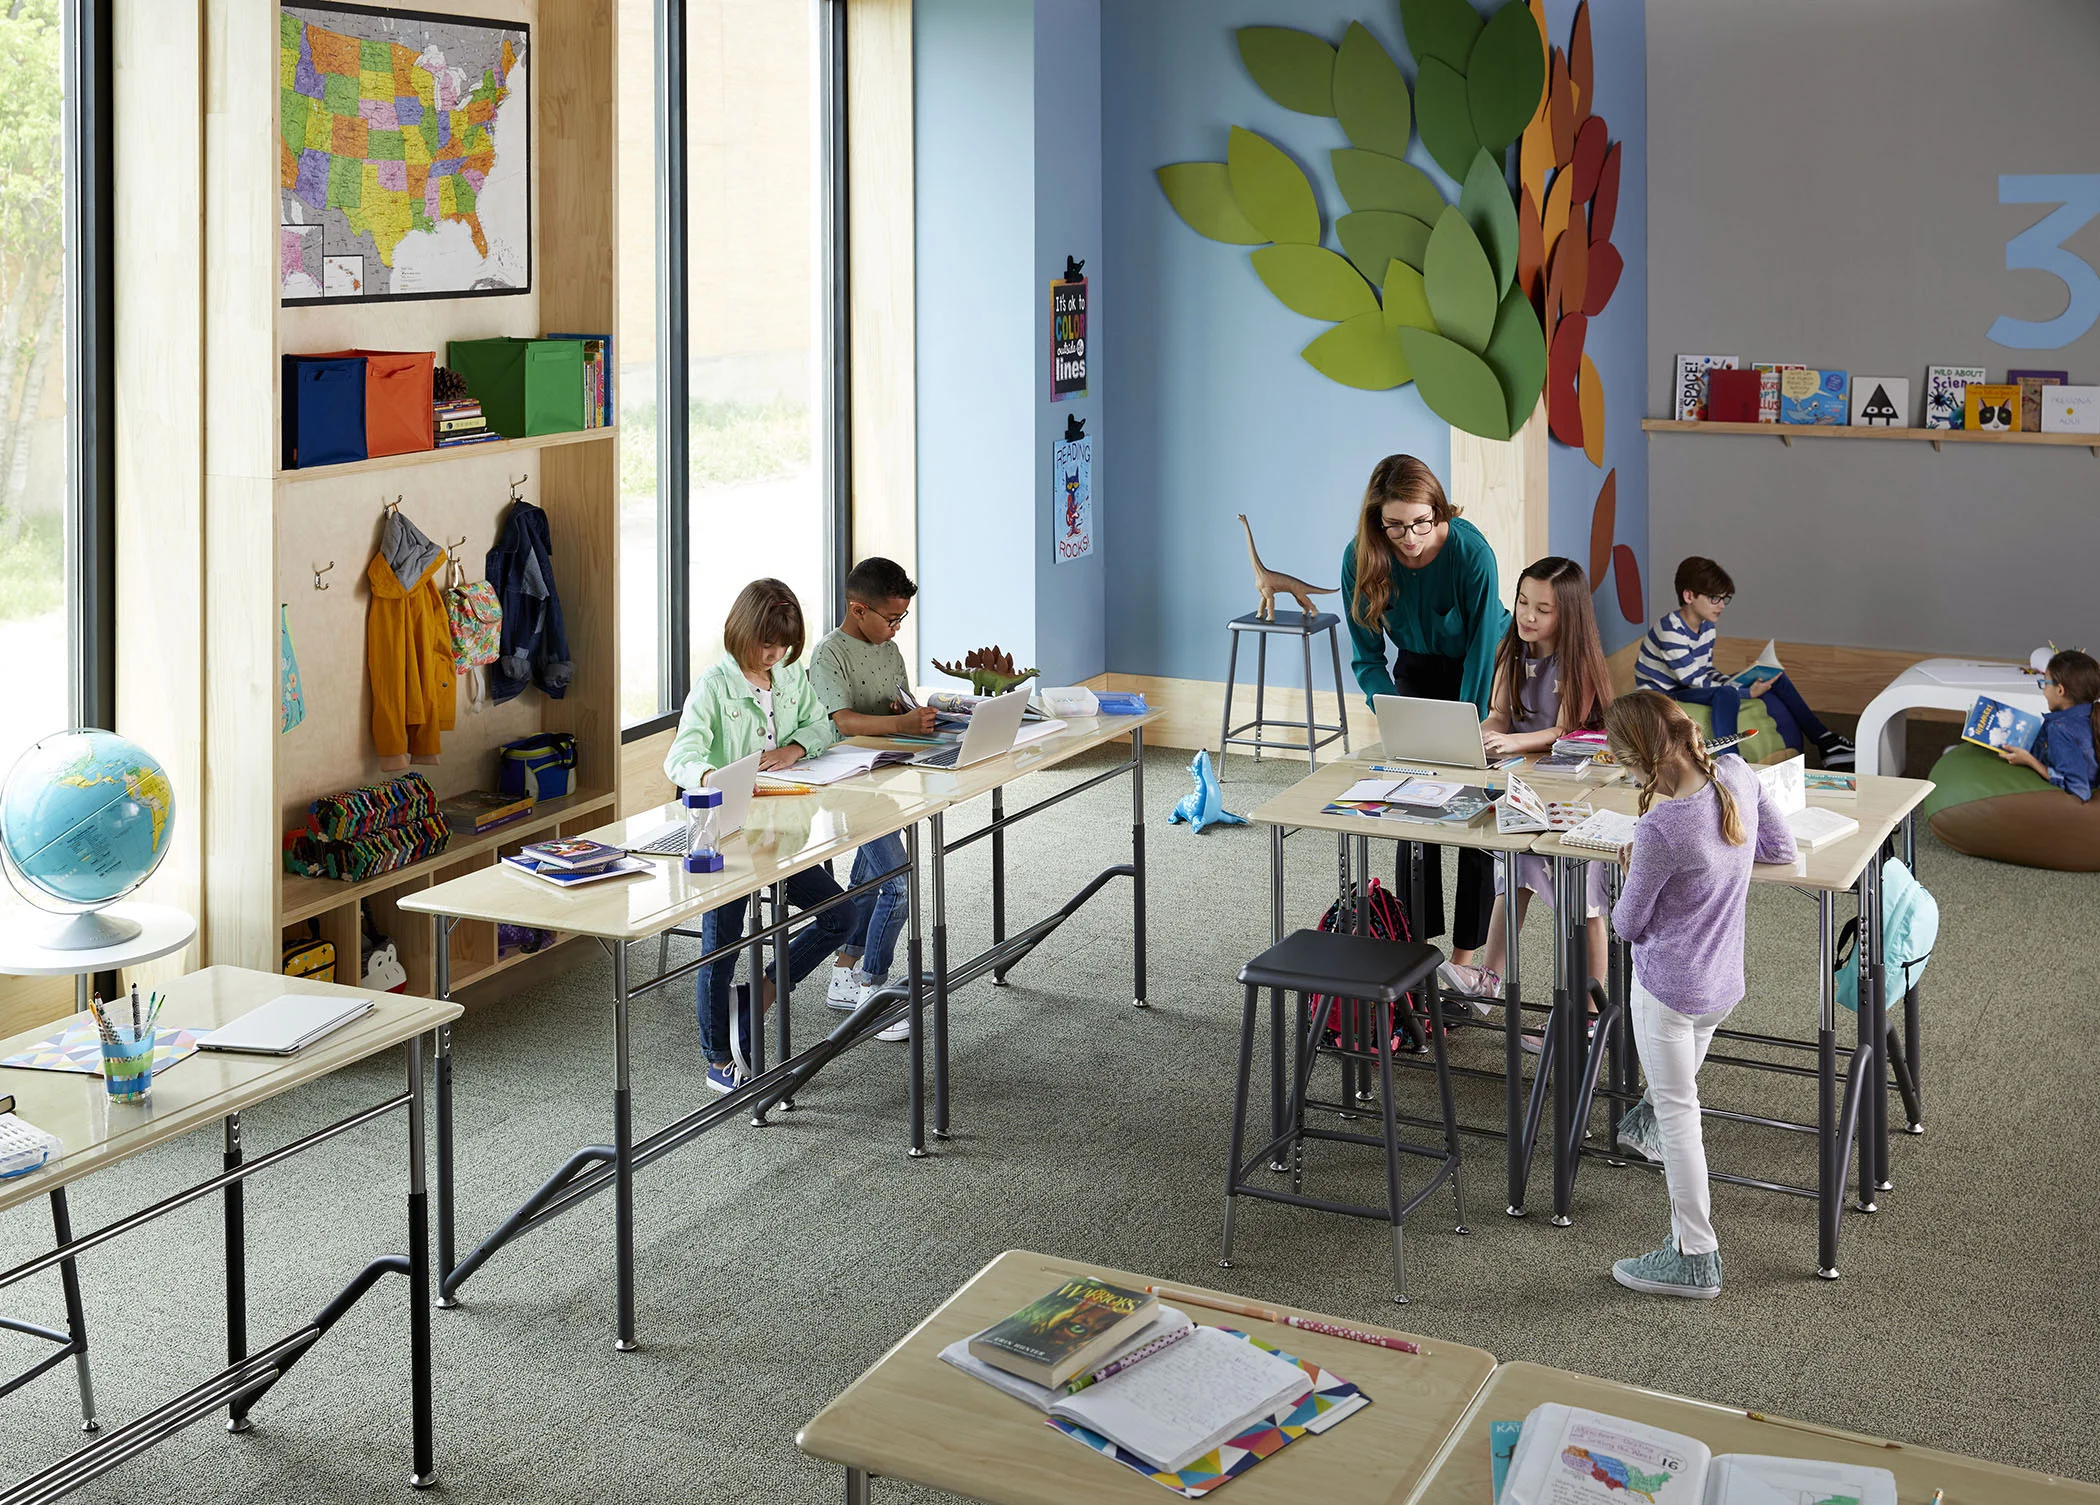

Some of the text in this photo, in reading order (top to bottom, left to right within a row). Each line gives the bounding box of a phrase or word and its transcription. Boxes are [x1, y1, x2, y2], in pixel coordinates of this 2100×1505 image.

[1984, 174, 2100, 350] 3
[1056, 293, 1085, 312] It's ok to
[1056, 314, 1085, 341] COLOR
[1056, 357, 1085, 381] lines
[1955, 369, 1984, 377] ABOUT
[1684, 362, 1698, 407] SPACE!
[1056, 443, 1091, 469] READING
[1057, 1282, 1136, 1313] WARRIORS
[1014, 1342, 1047, 1357] HUNTER
[1661, 1458, 1679, 1471] 16
